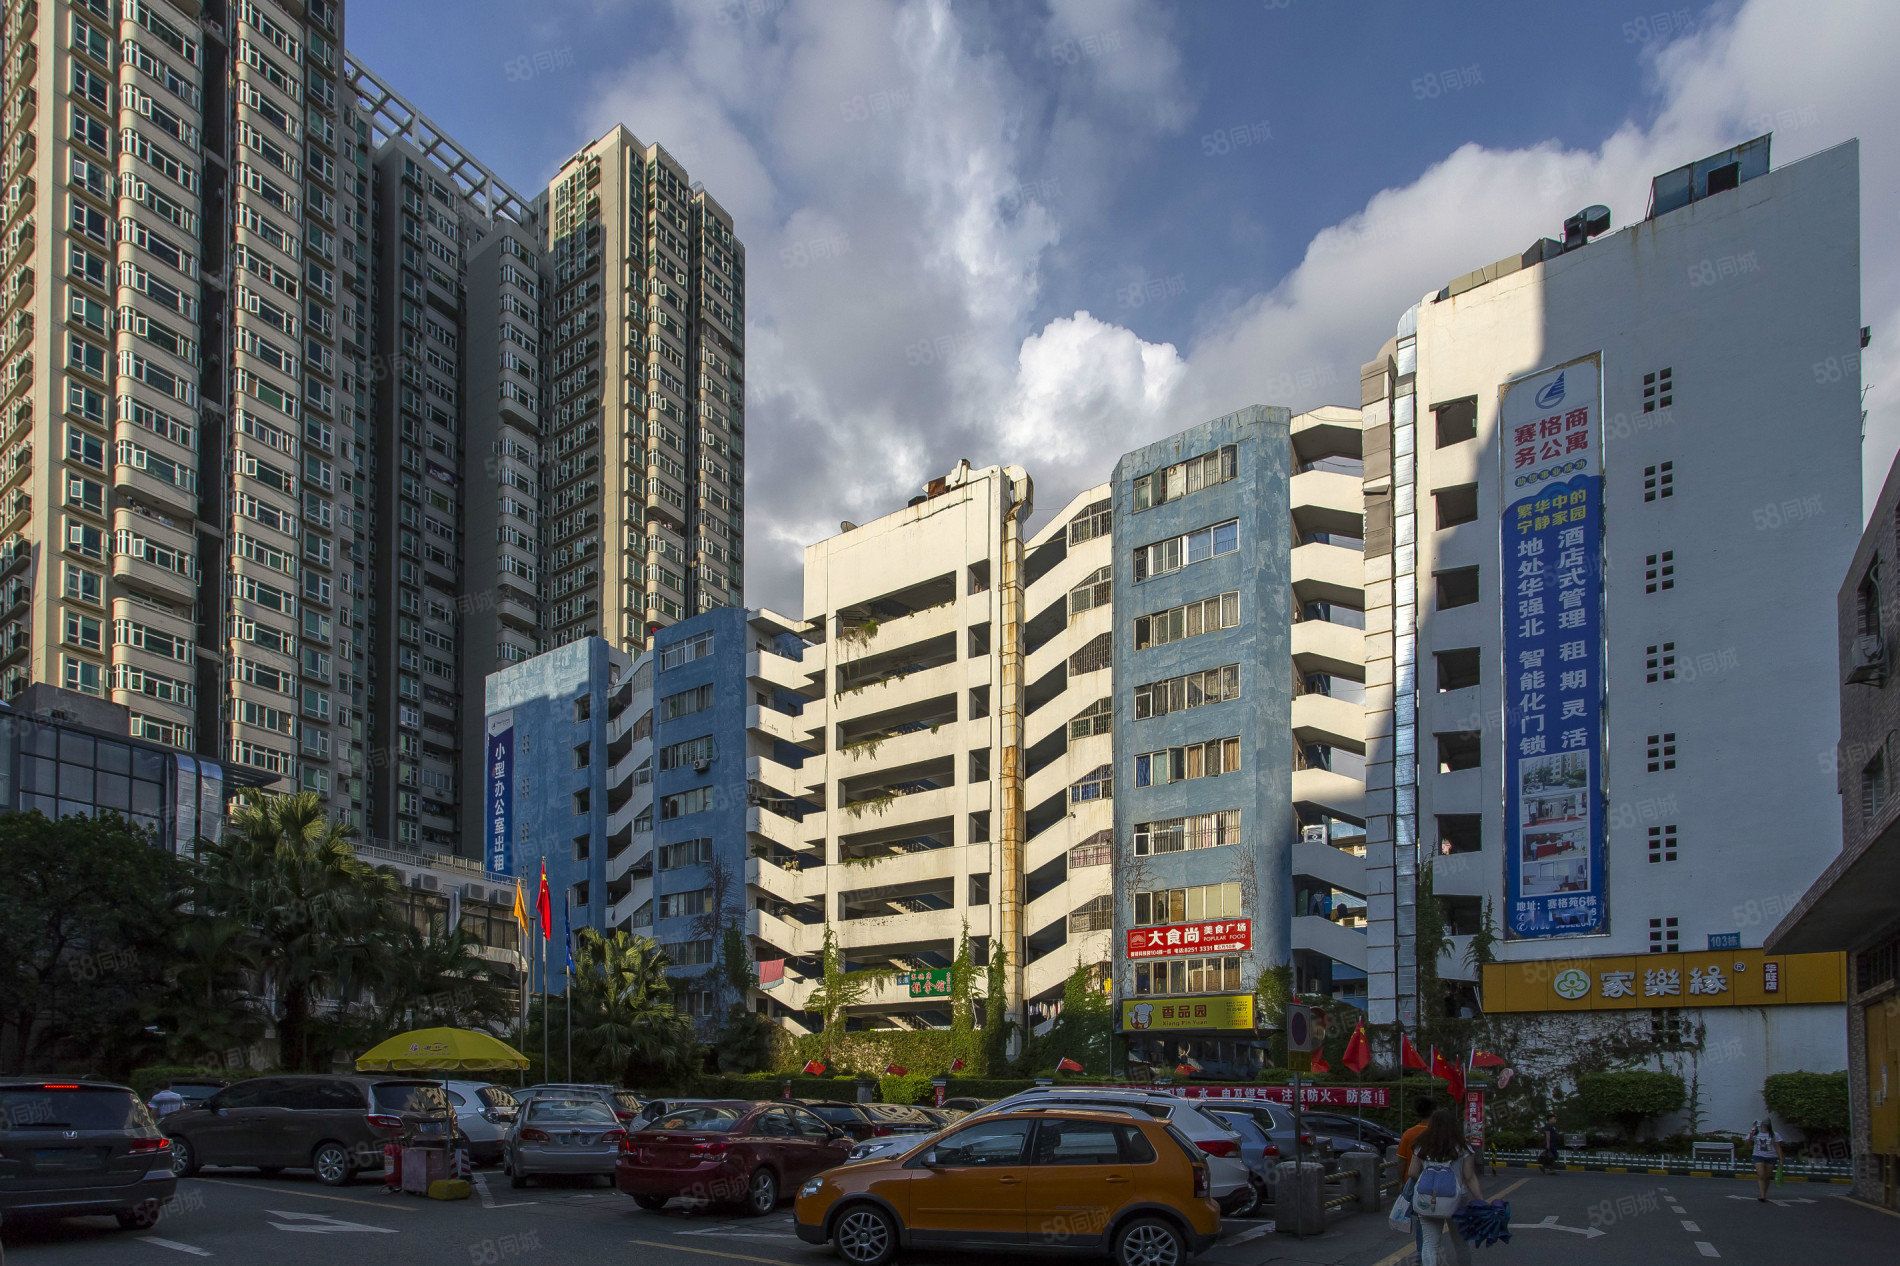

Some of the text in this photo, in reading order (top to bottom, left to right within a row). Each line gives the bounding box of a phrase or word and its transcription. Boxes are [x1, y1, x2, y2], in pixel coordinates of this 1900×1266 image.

[1514, 406, 1588, 447] 赛格商
[1514, 429, 1588, 469] 务公寓
[1517, 489, 1586, 519] 繁华中的
[1517, 505, 1586, 534] 宁静家园
[1517, 537, 1547, 755] 地处华强北 智能化门锁
[1558, 526, 1588, 748] 酒店式管理 租期灵活
[493, 742, 506, 872] 小型办公室出租
[1148, 927, 1200, 947] 大食尚
[1203, 922, 1246, 935] 美食广场
[1710, 935, 1738, 947] 103栋
[1765, 964, 1777, 990] 华旺店
[1162, 1004, 1207, 1019] 香品园
